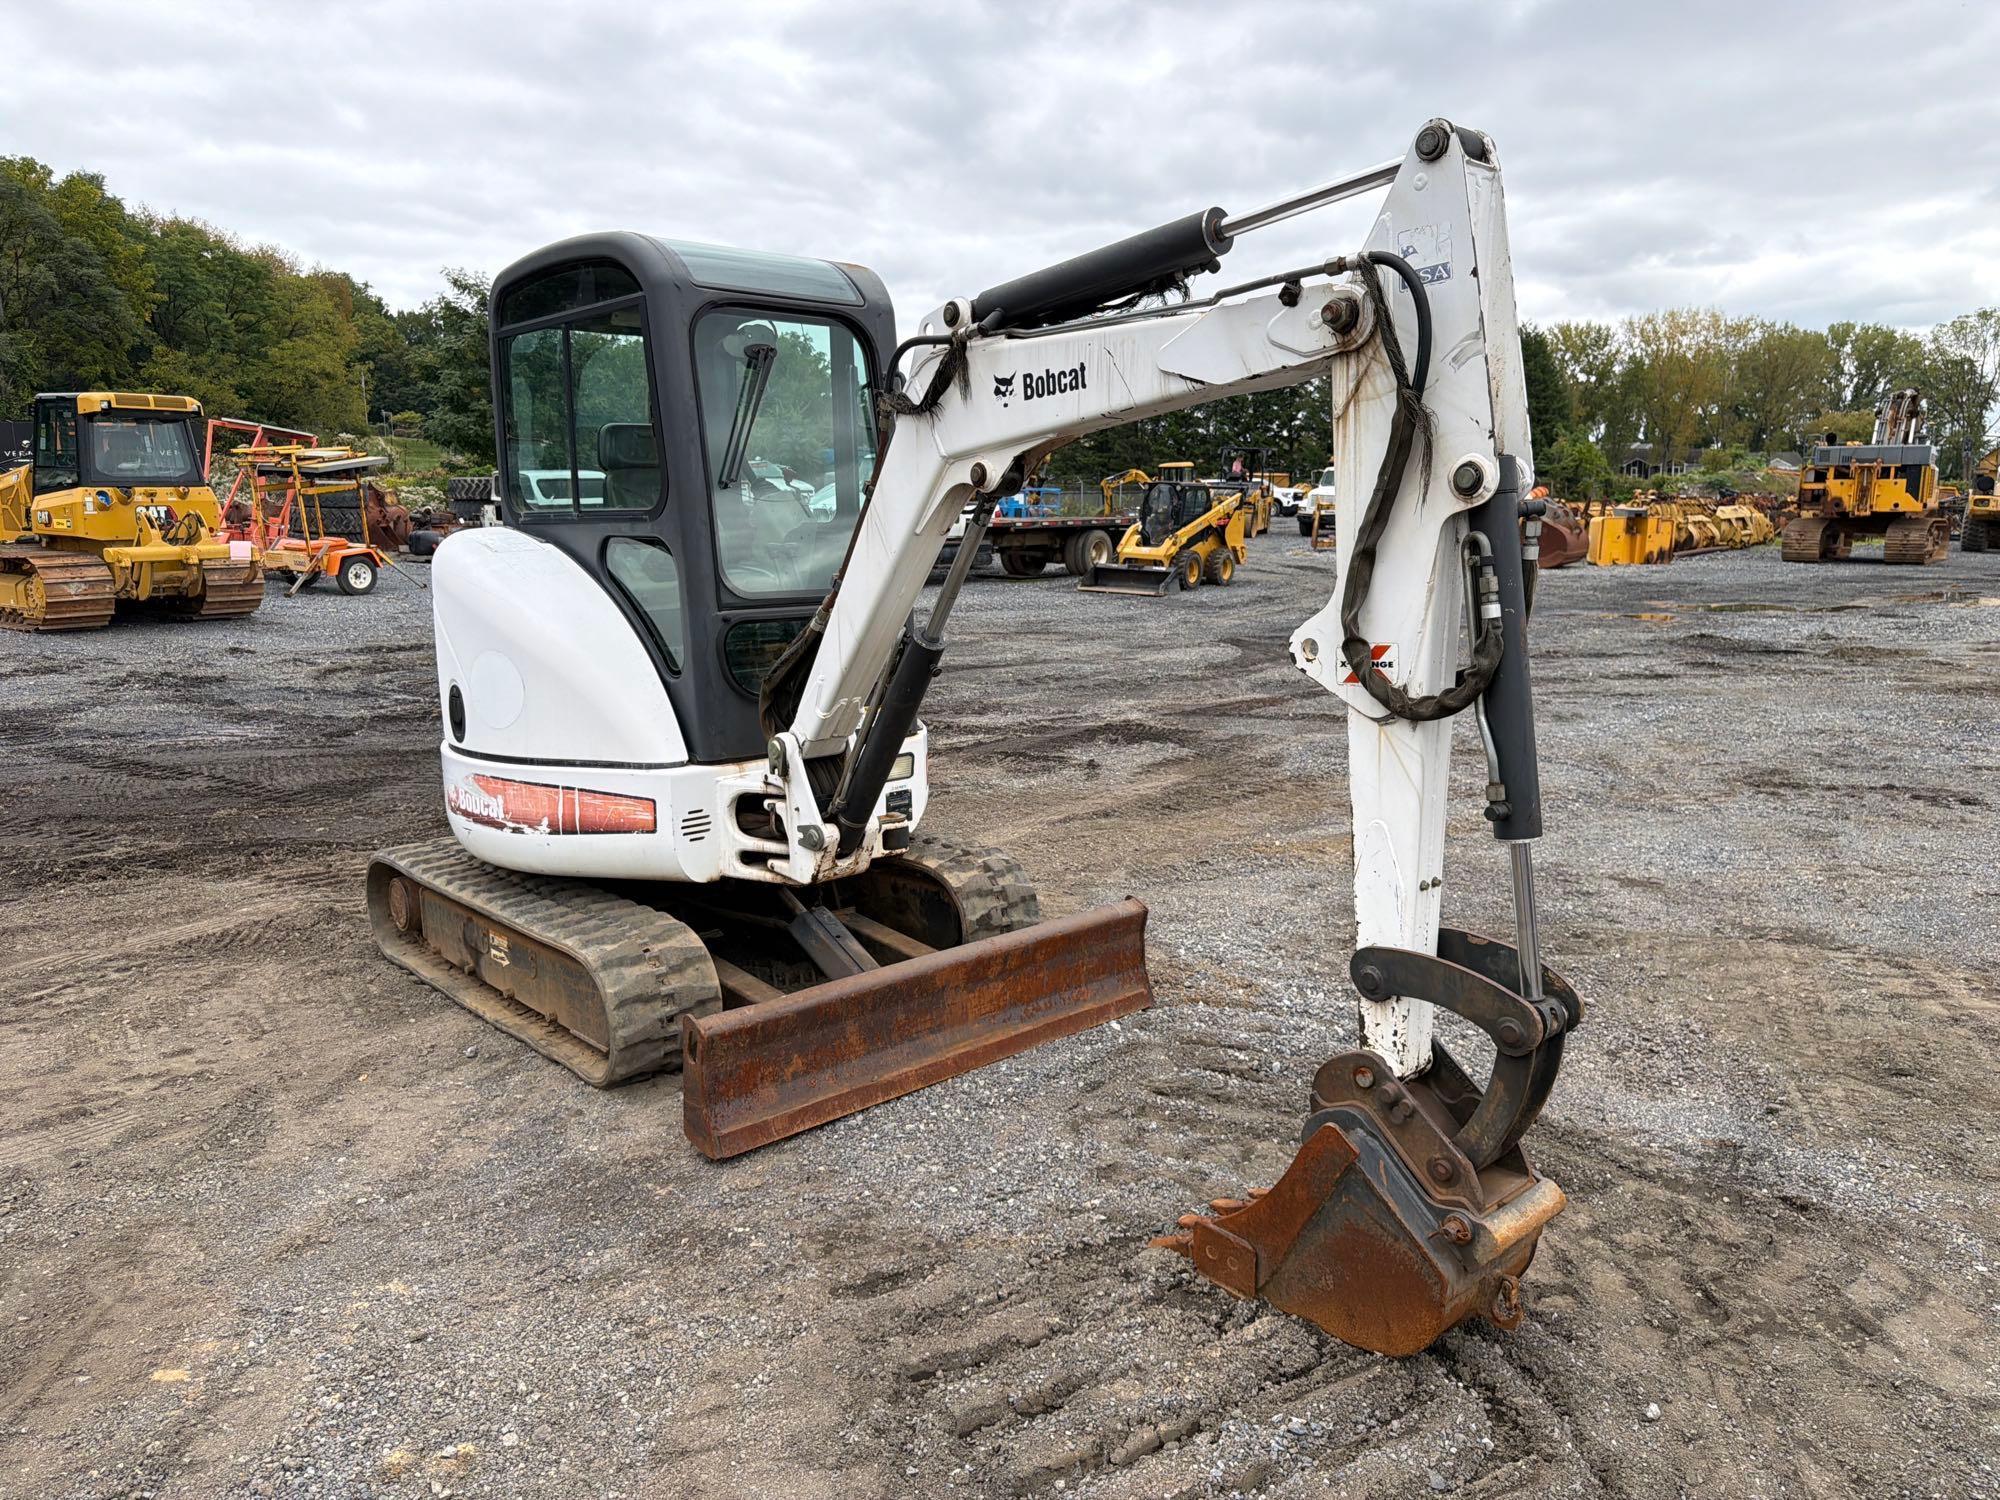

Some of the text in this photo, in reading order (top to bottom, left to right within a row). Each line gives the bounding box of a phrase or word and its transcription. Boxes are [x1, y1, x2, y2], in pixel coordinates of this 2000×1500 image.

[1022, 361, 1087, 401] Bobcat
[37, 510, 49, 524] CAT
[1340, 660, 1394, 668] X-NGE
